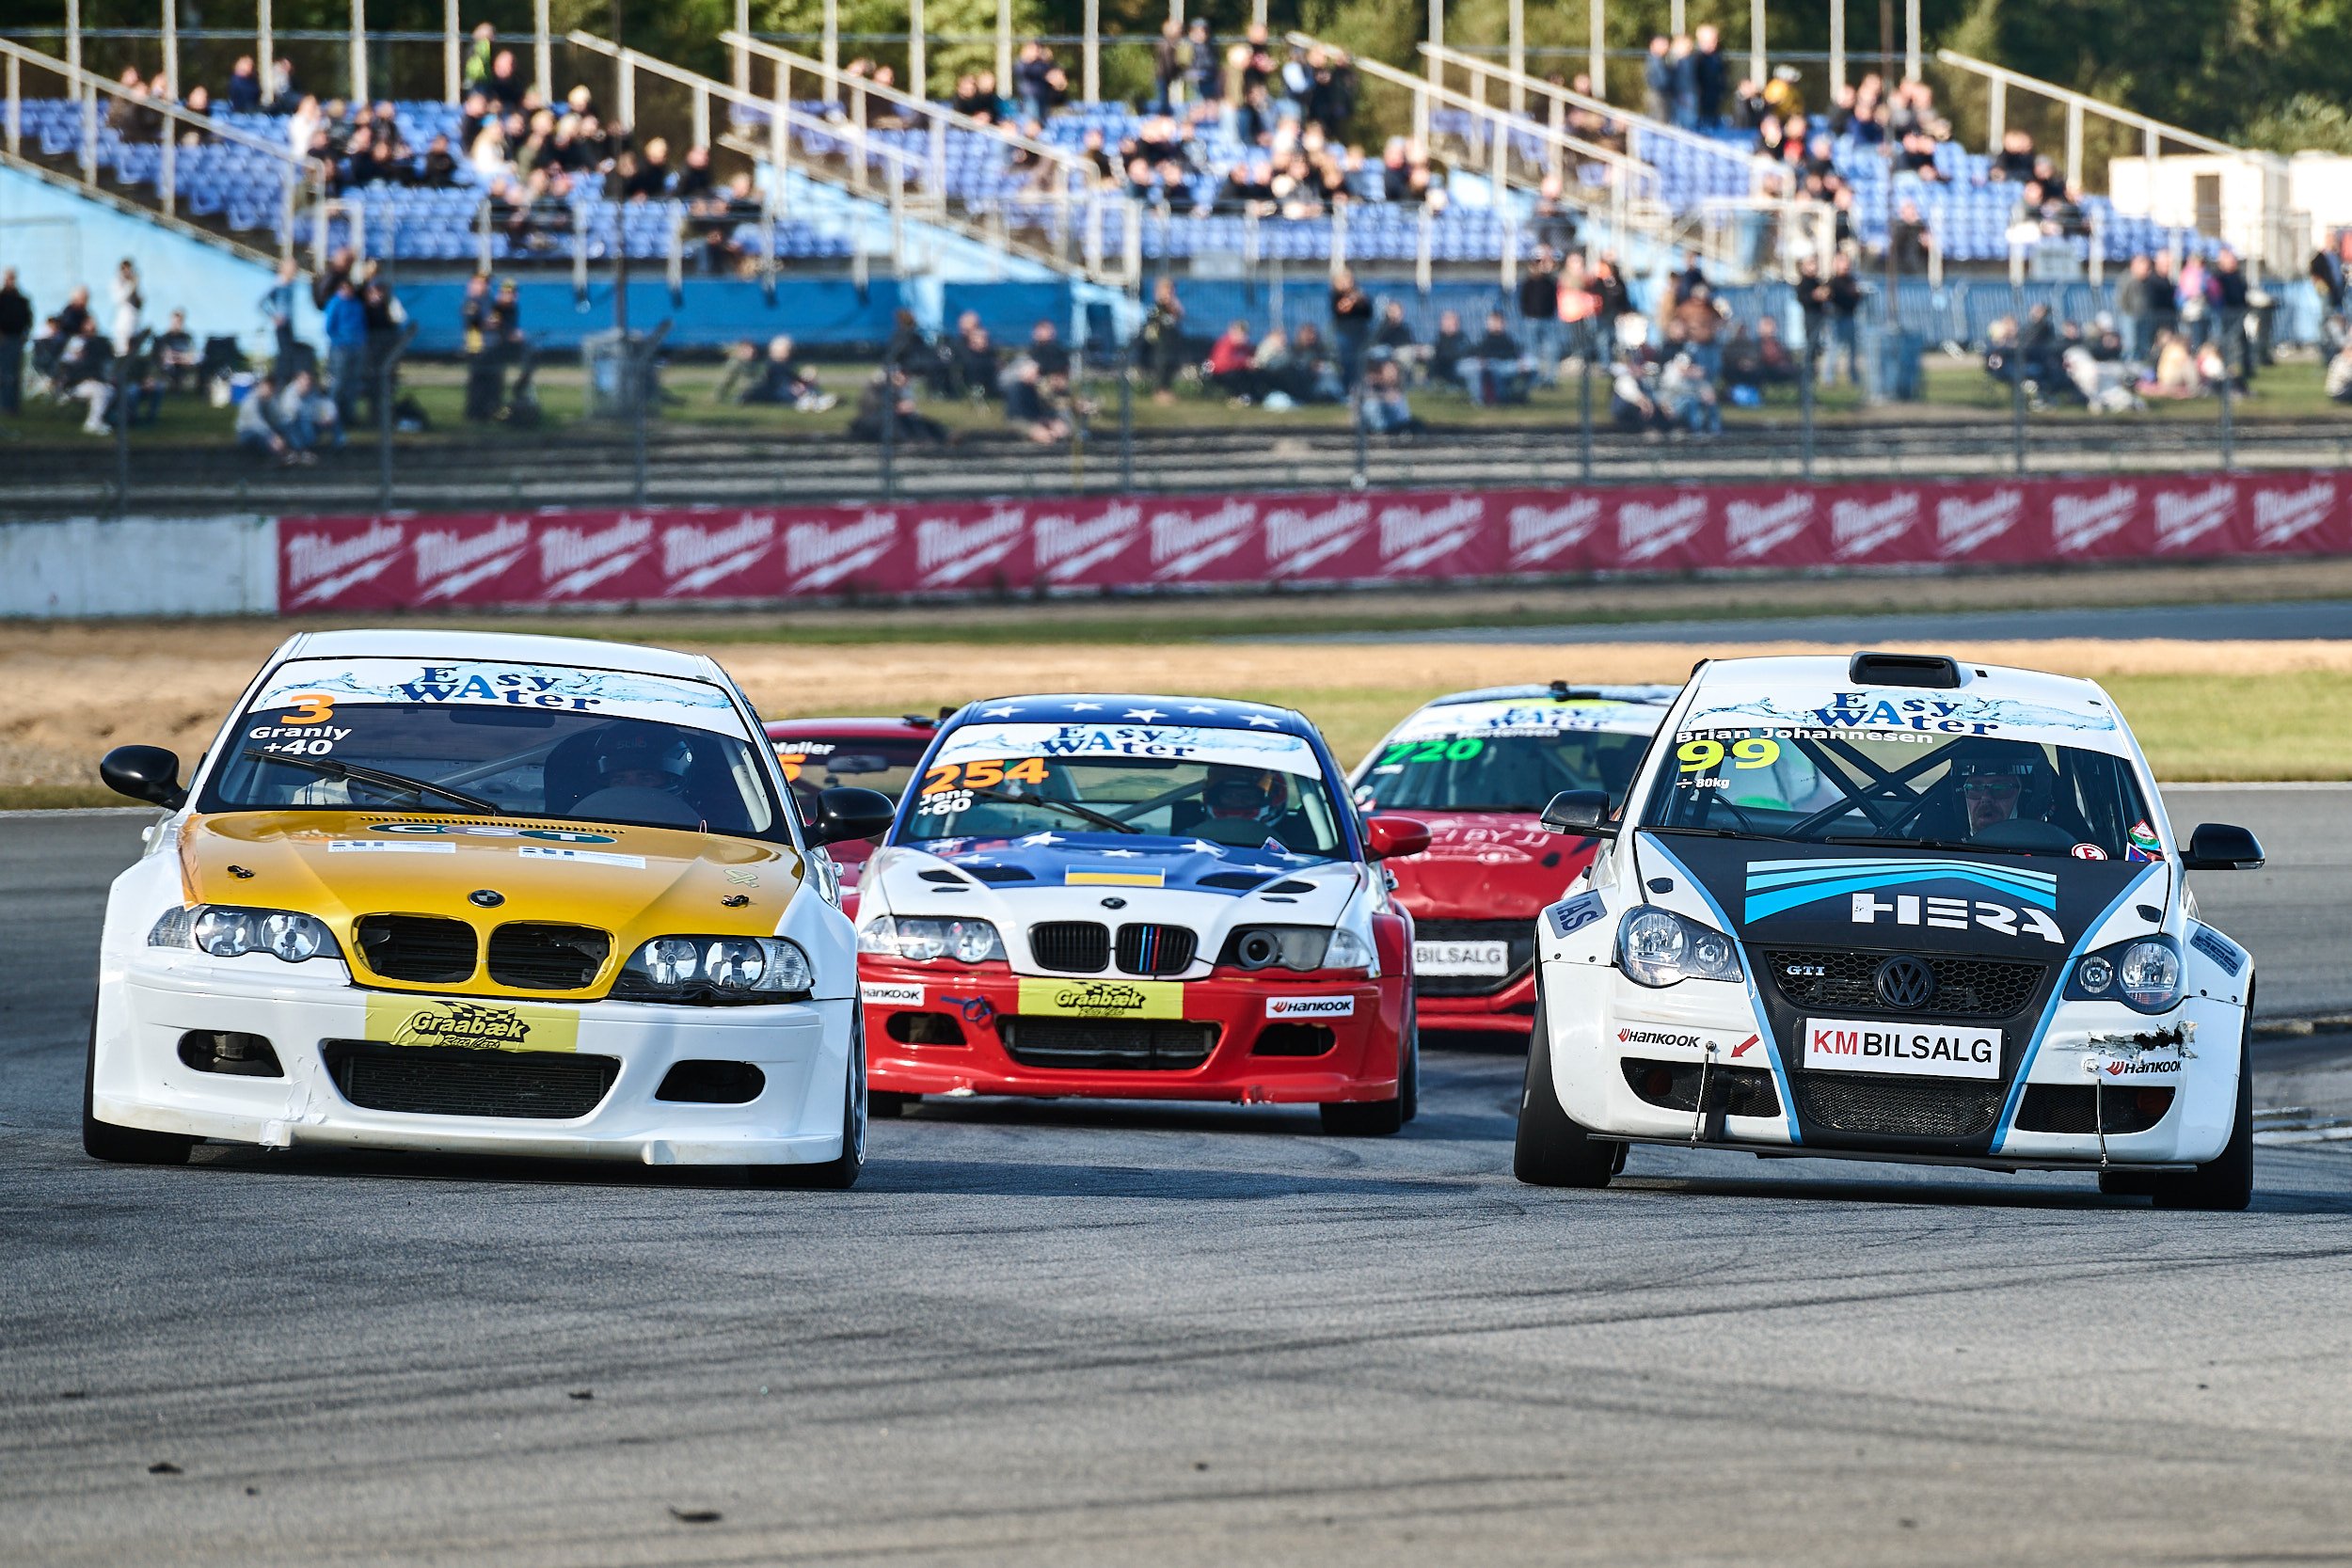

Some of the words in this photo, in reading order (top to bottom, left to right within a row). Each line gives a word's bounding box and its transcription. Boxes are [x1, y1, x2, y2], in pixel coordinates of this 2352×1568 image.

[280, 694, 336, 725] 3
[249, 726, 352, 740] Granly
[1677, 727, 1751, 743] Brian
[1758, 727, 1934, 744] Johannesen
[263, 739, 333, 755] +40
[1380, 738, 1485, 766] 720
[1677, 738, 1780, 772] 99
[921, 757, 1049, 796] 254
[1695, 777, 1730, 790] 80kg
[919, 788, 975, 806] Jens
[918, 799, 971, 816] +60
[1851, 893, 2065, 944] HERA
[1787, 965, 1825, 975] GTI
[412, 1011, 527, 1039] Graabæk
